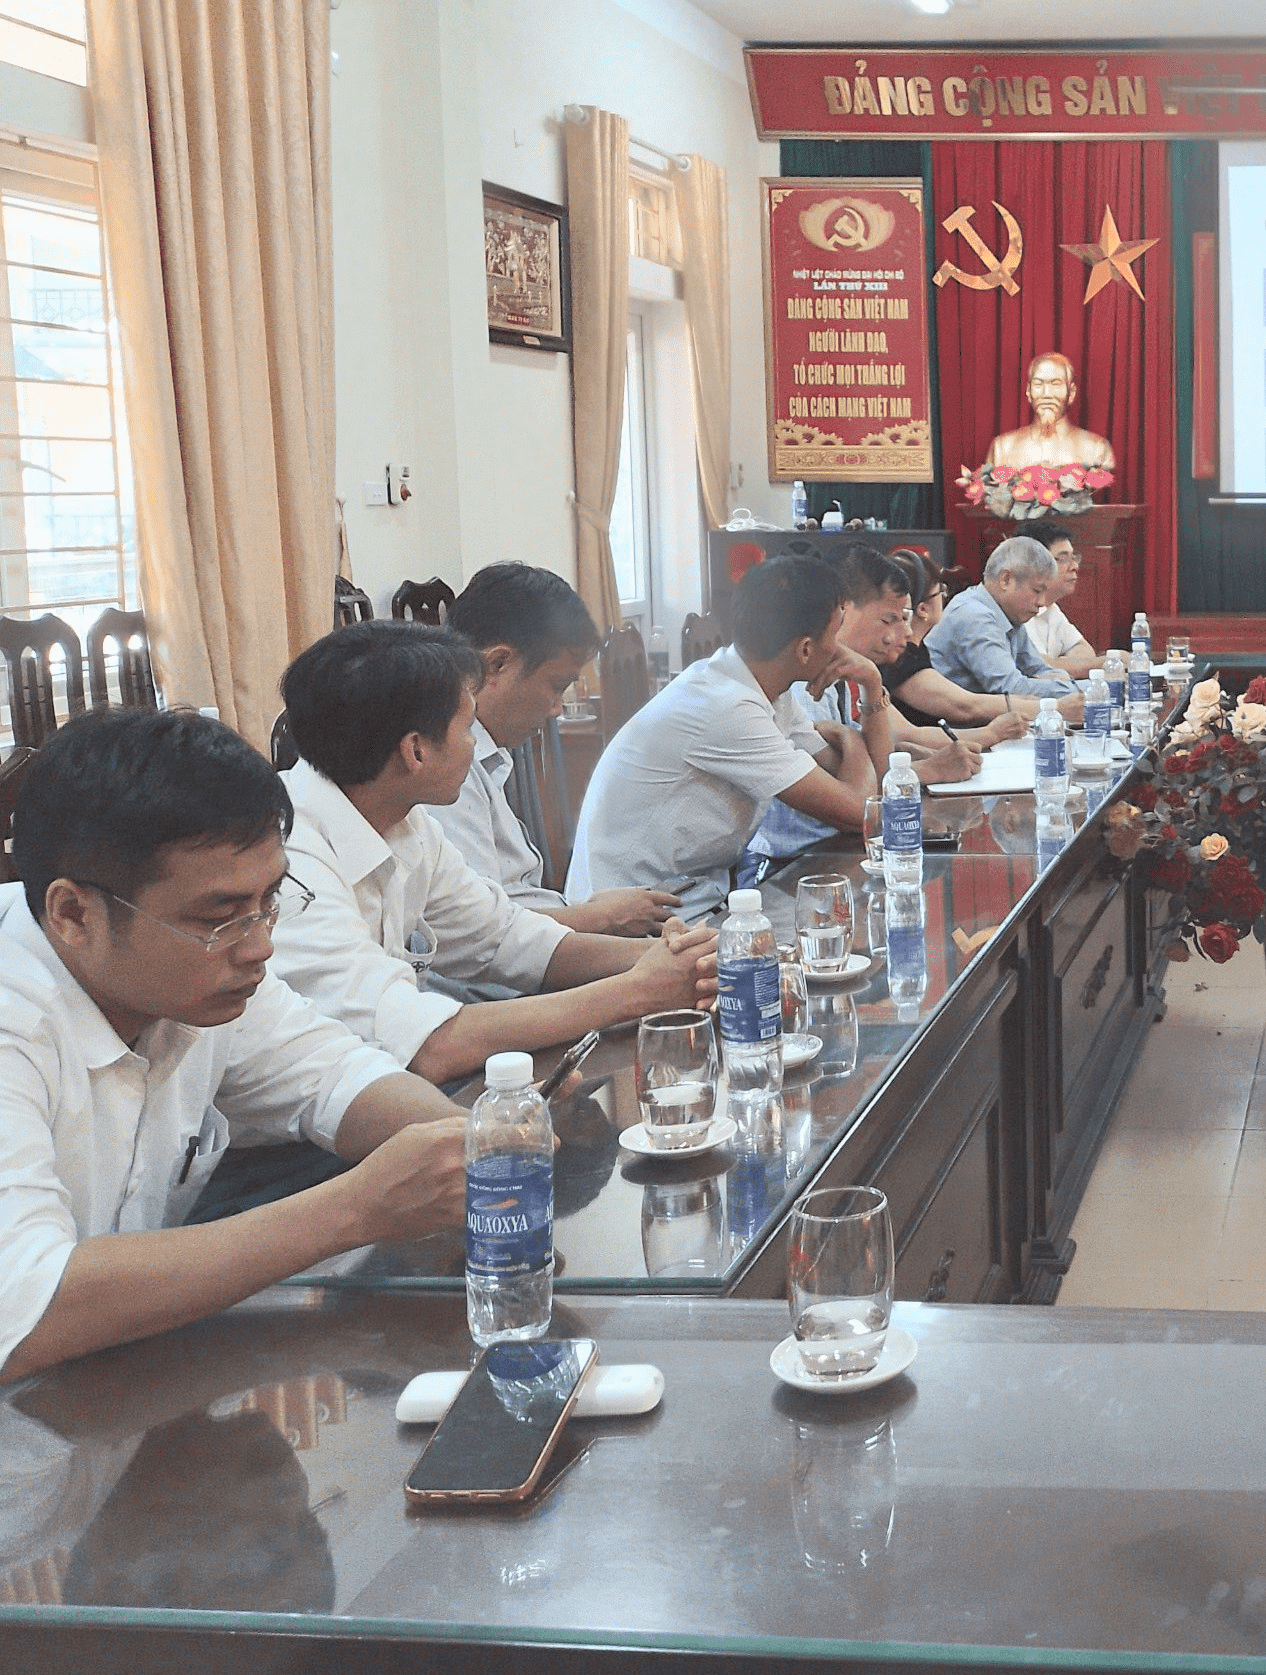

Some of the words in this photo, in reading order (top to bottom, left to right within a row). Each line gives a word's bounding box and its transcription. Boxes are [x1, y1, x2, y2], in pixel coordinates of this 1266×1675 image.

[823, 59, 935, 116] ĐẢNG
[942, 64, 1053, 127] CỘNG
[1062, 60, 1148, 116] SẢN
[787, 293, 813, 320] ĐẢNG
[815, 294, 842, 323] CỘNG
[843, 293, 862, 320] SẢN
[864, 294, 885, 323] VIỆT
[887, 298, 909, 320] NAM
[808, 328, 839, 352] NGƯỜI
[793, 357, 806, 385] TỔ
[807, 360, 834, 385] CHỨC
[836, 364, 855, 389] MỌI
[856, 358, 888, 386] THẮNG
[789, 392, 809, 417] CỦA
[810, 393, 836, 418] CÁCH
[867, 393, 888, 421] VIỆT
[890, 397, 911, 418] NAM
